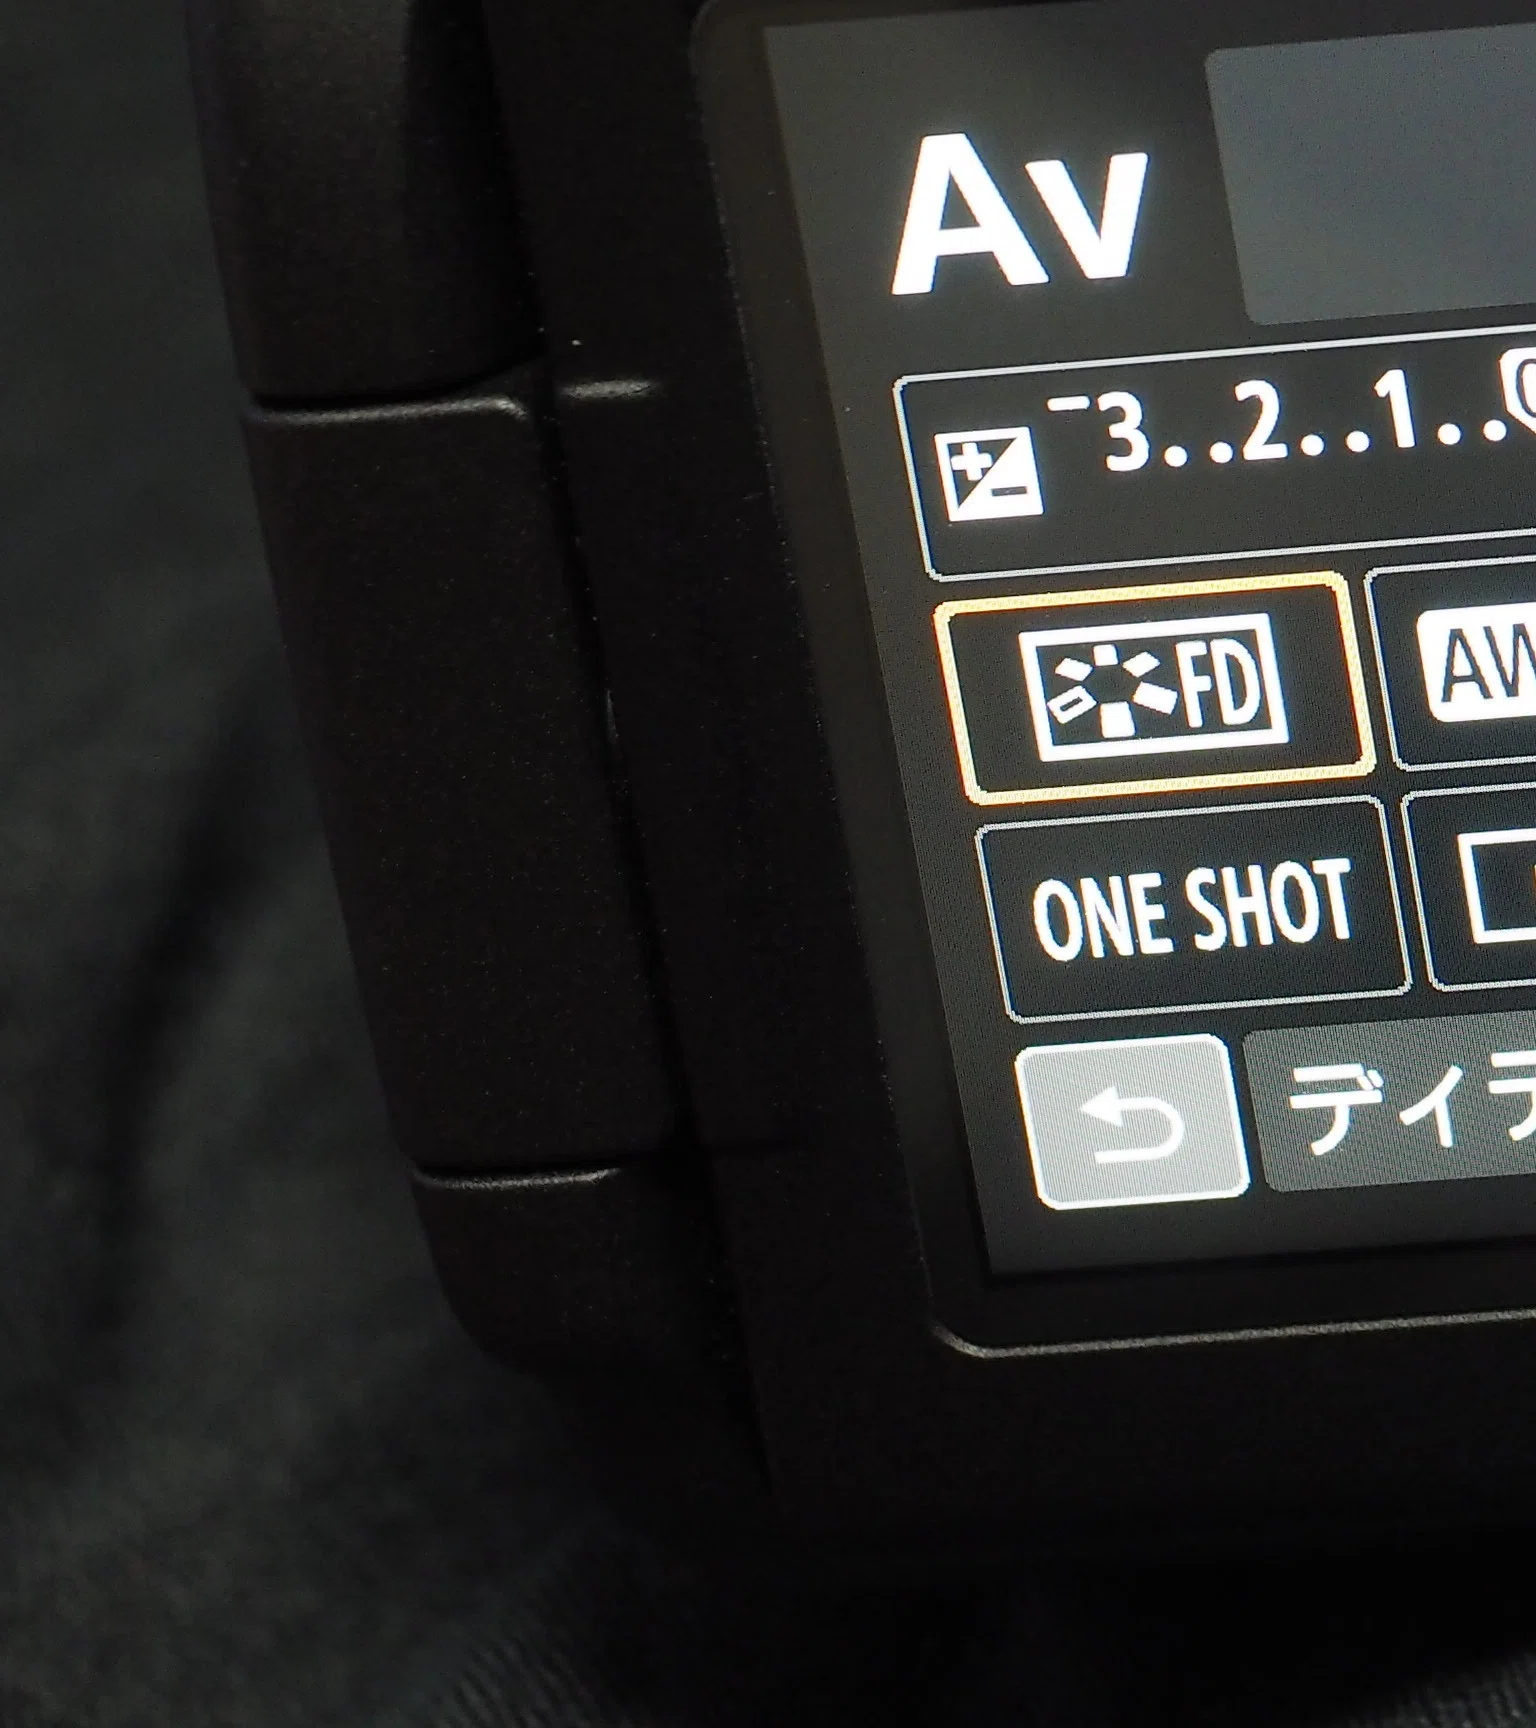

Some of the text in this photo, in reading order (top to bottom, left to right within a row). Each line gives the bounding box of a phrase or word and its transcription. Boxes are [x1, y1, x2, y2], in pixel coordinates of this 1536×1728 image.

[891, 132, 1149, 296] Av
[1180, 637, 1262, 728] FD
[1033, 857, 1351, 962] ONE SHOT
